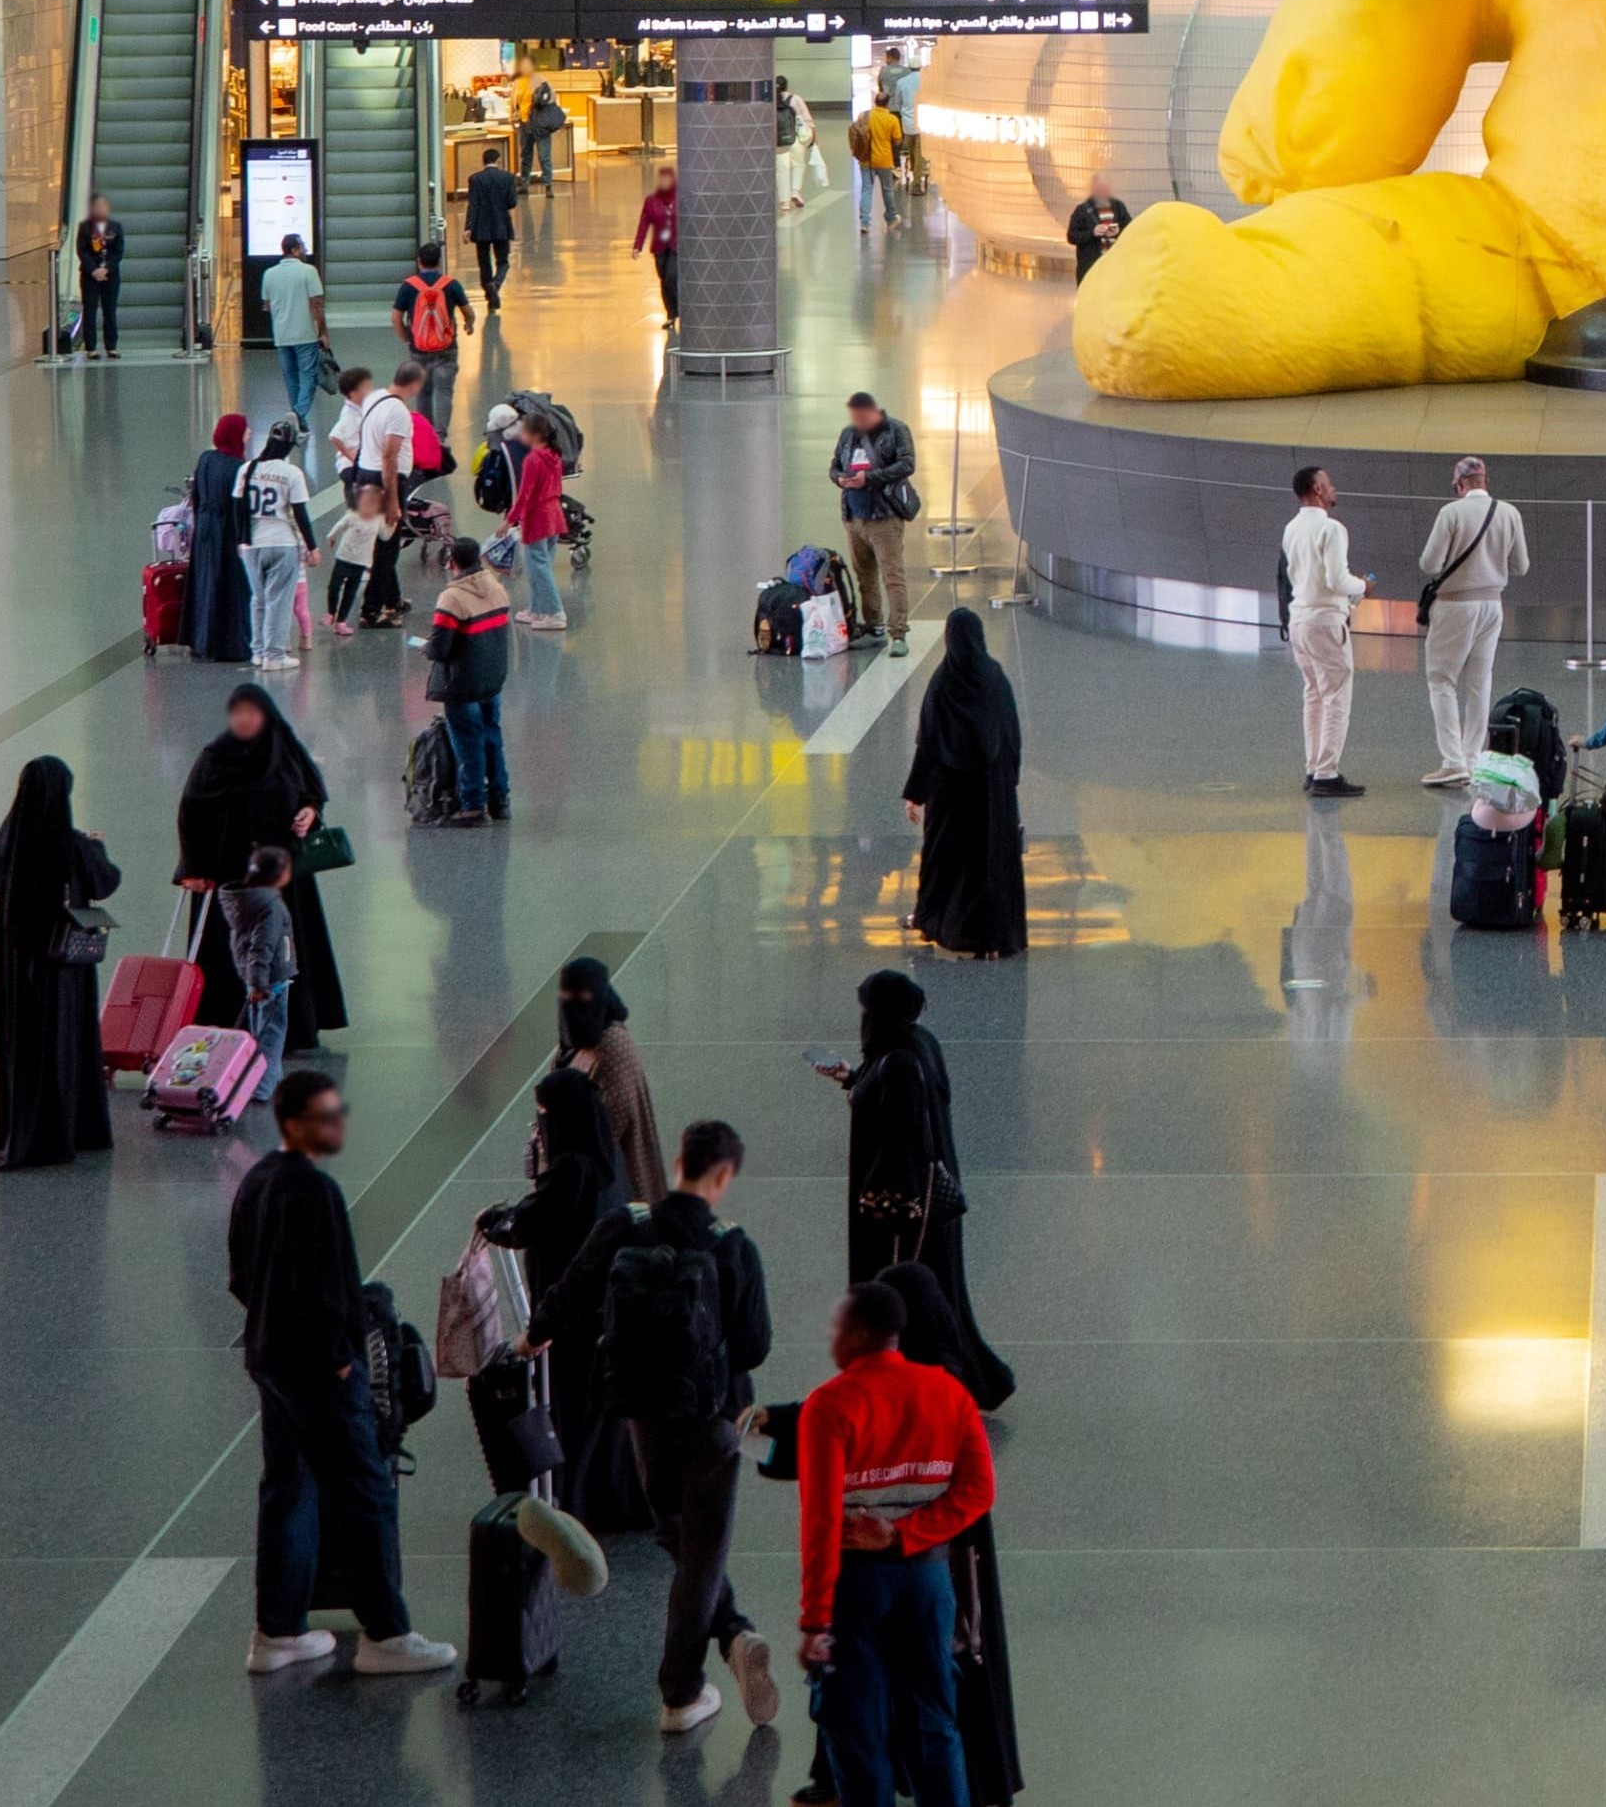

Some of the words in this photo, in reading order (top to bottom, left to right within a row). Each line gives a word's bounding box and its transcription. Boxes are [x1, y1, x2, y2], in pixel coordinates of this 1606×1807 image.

[298, 19, 325, 32] Food
[326, 19, 357, 32] Court
[365, 19, 411, 35] المطاعم
[412, 19, 434, 34] ركن
[638, 16, 651, 30] Al
[778, 16, 806, 29] صالة
[884, 16, 910, 28] Hotel
[921, 16, 943, 31] Spa
[1025, 16, 1059, 30] الفندق
[869, 1461, 917, 1484] SECURITY
